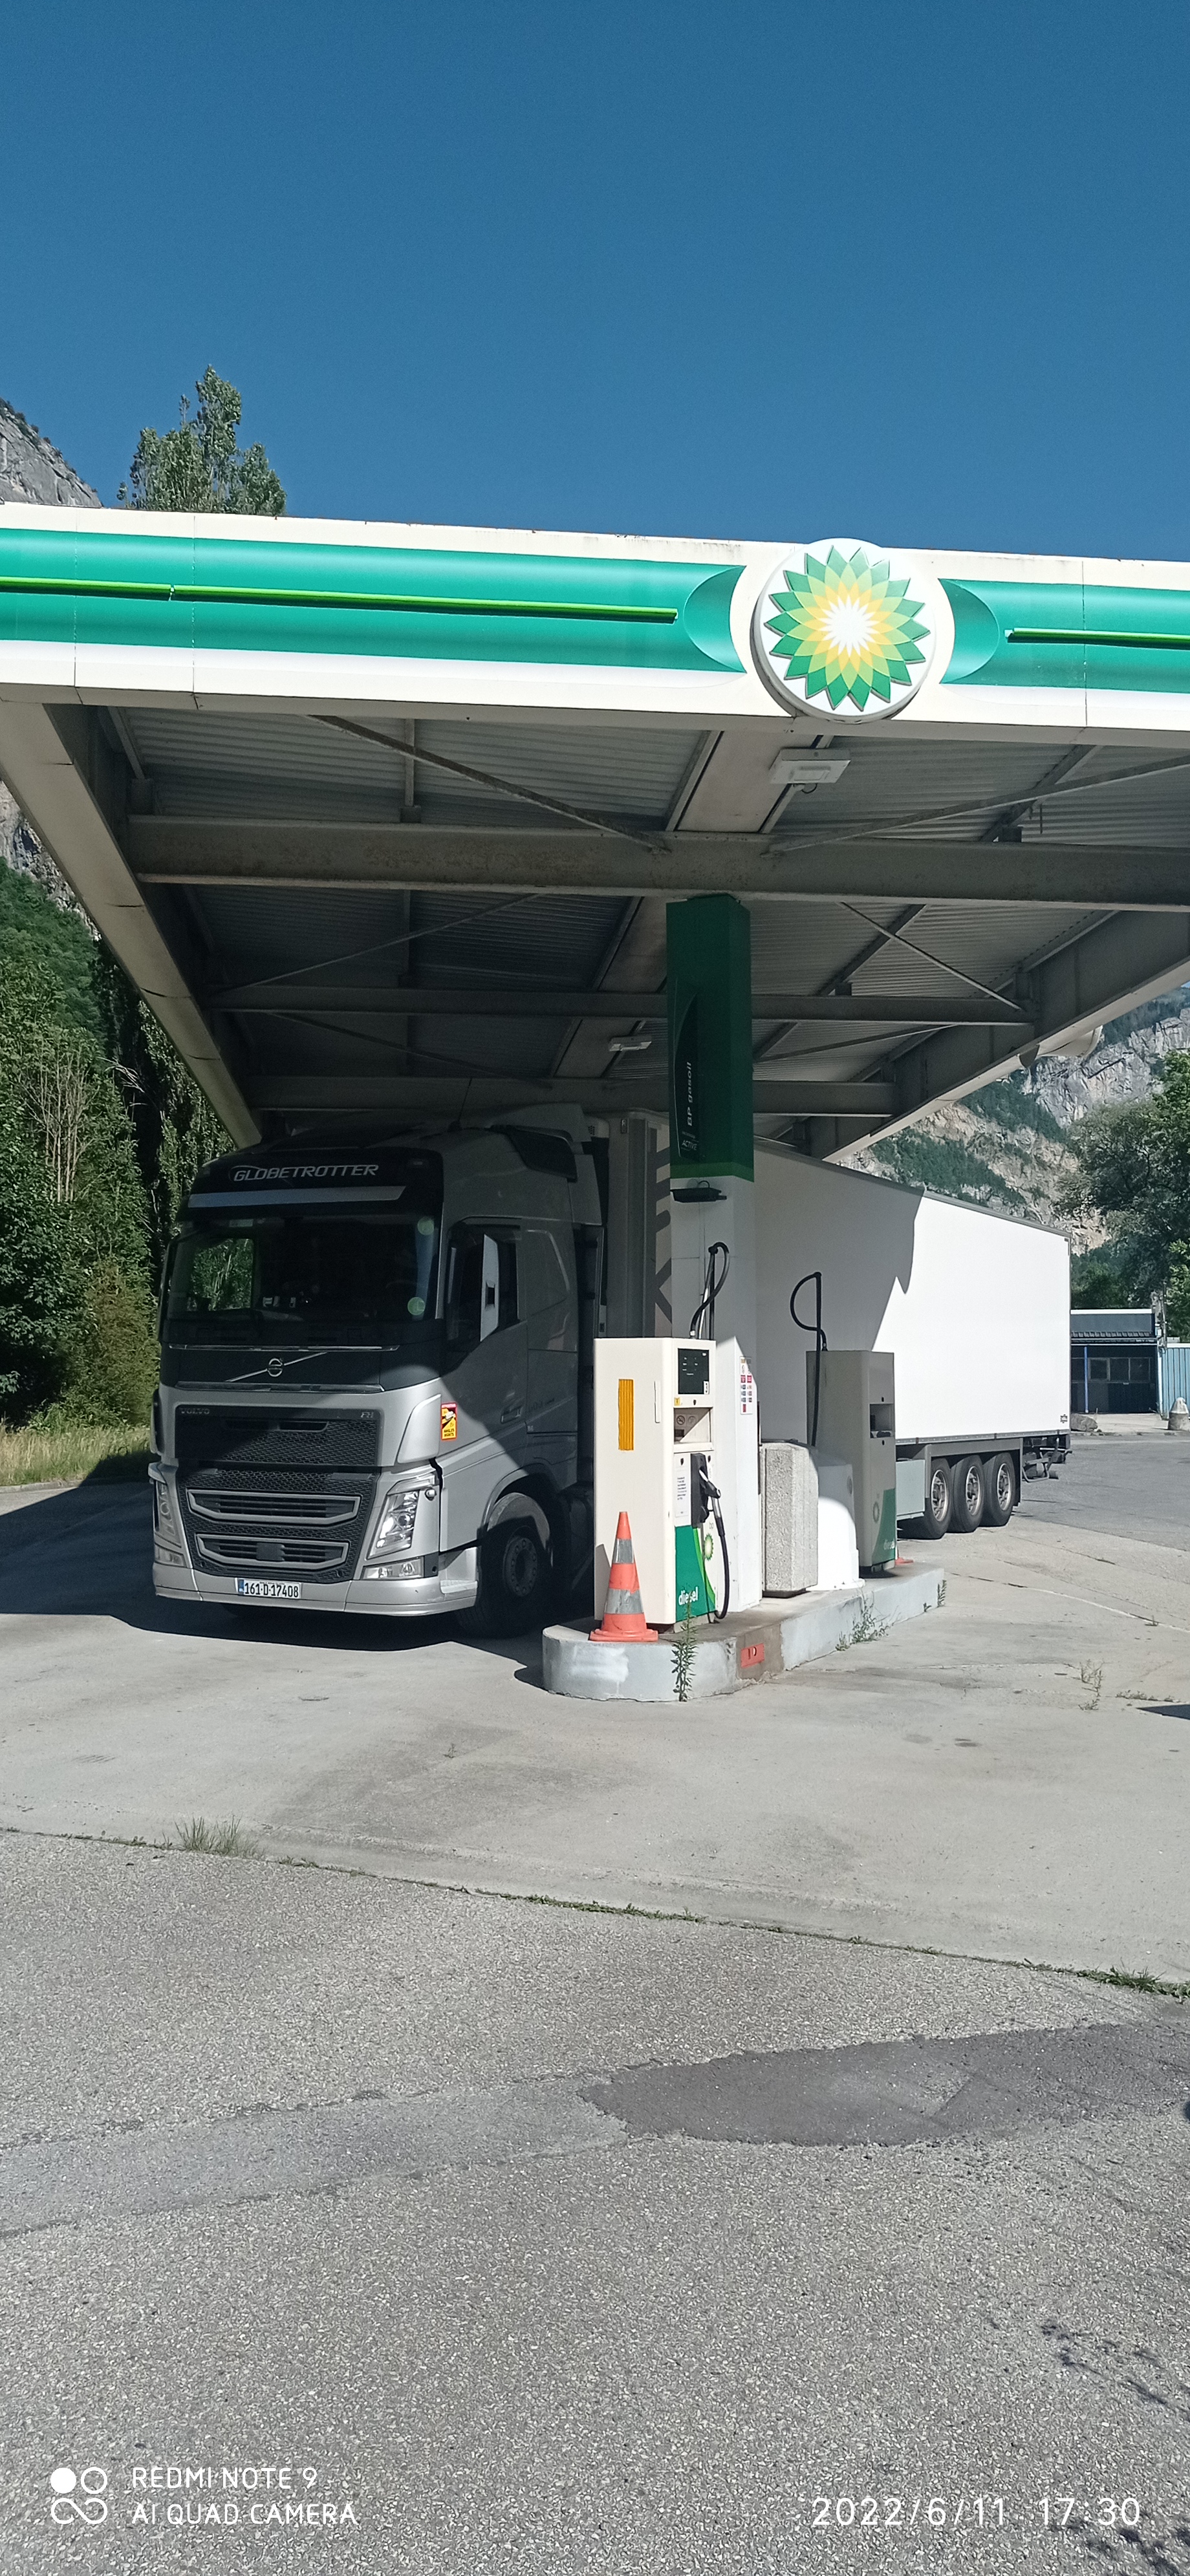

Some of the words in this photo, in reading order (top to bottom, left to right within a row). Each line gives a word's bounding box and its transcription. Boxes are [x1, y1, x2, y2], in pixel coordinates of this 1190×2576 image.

[687, 1106, 693, 1126] BP
[233, 1165, 379, 1182] GLOBETROTTER
[678, 1586, 698, 1605] diesel
